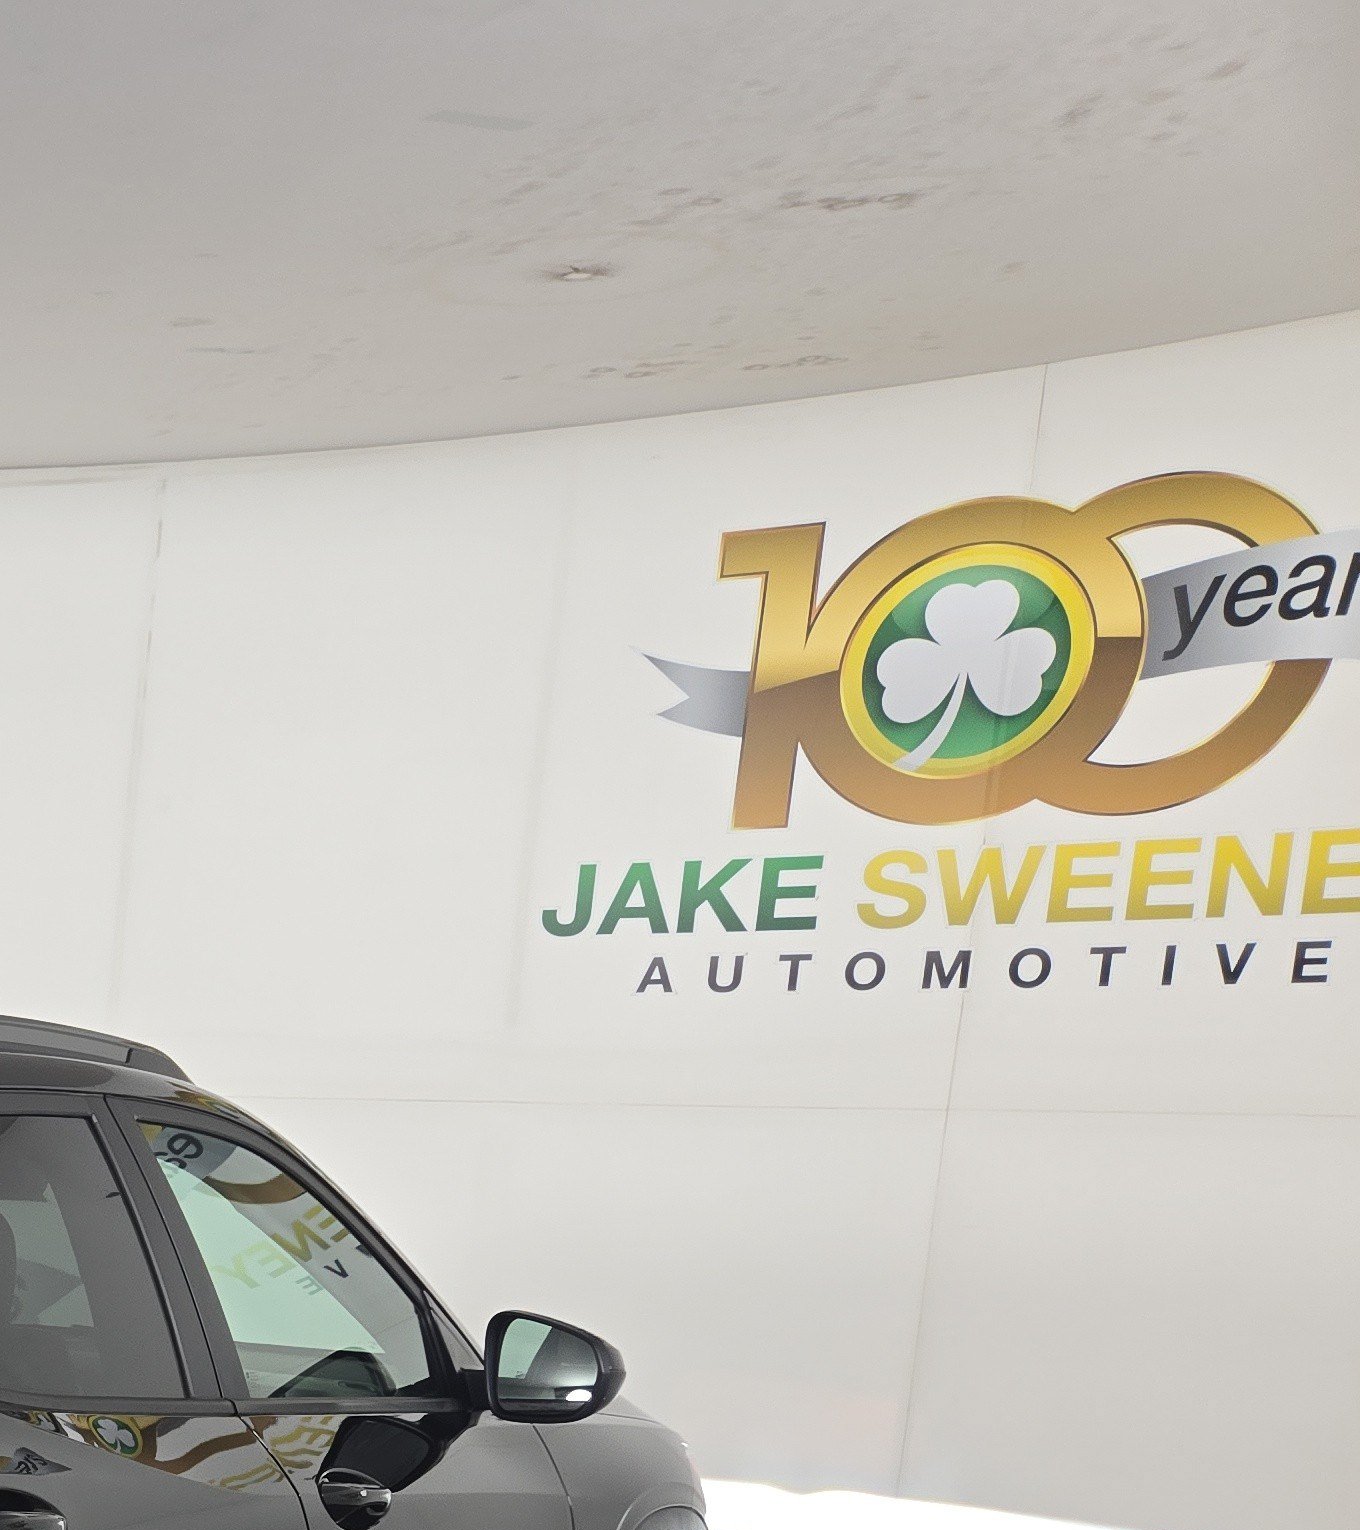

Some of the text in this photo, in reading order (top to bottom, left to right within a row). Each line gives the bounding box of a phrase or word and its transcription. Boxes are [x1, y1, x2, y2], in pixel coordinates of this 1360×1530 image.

[1162, 552, 1360, 661] year
[541, 828, 1360, 938] JAKE SWEENE
[635, 940, 1333, 995] AUTOMOTIVE
